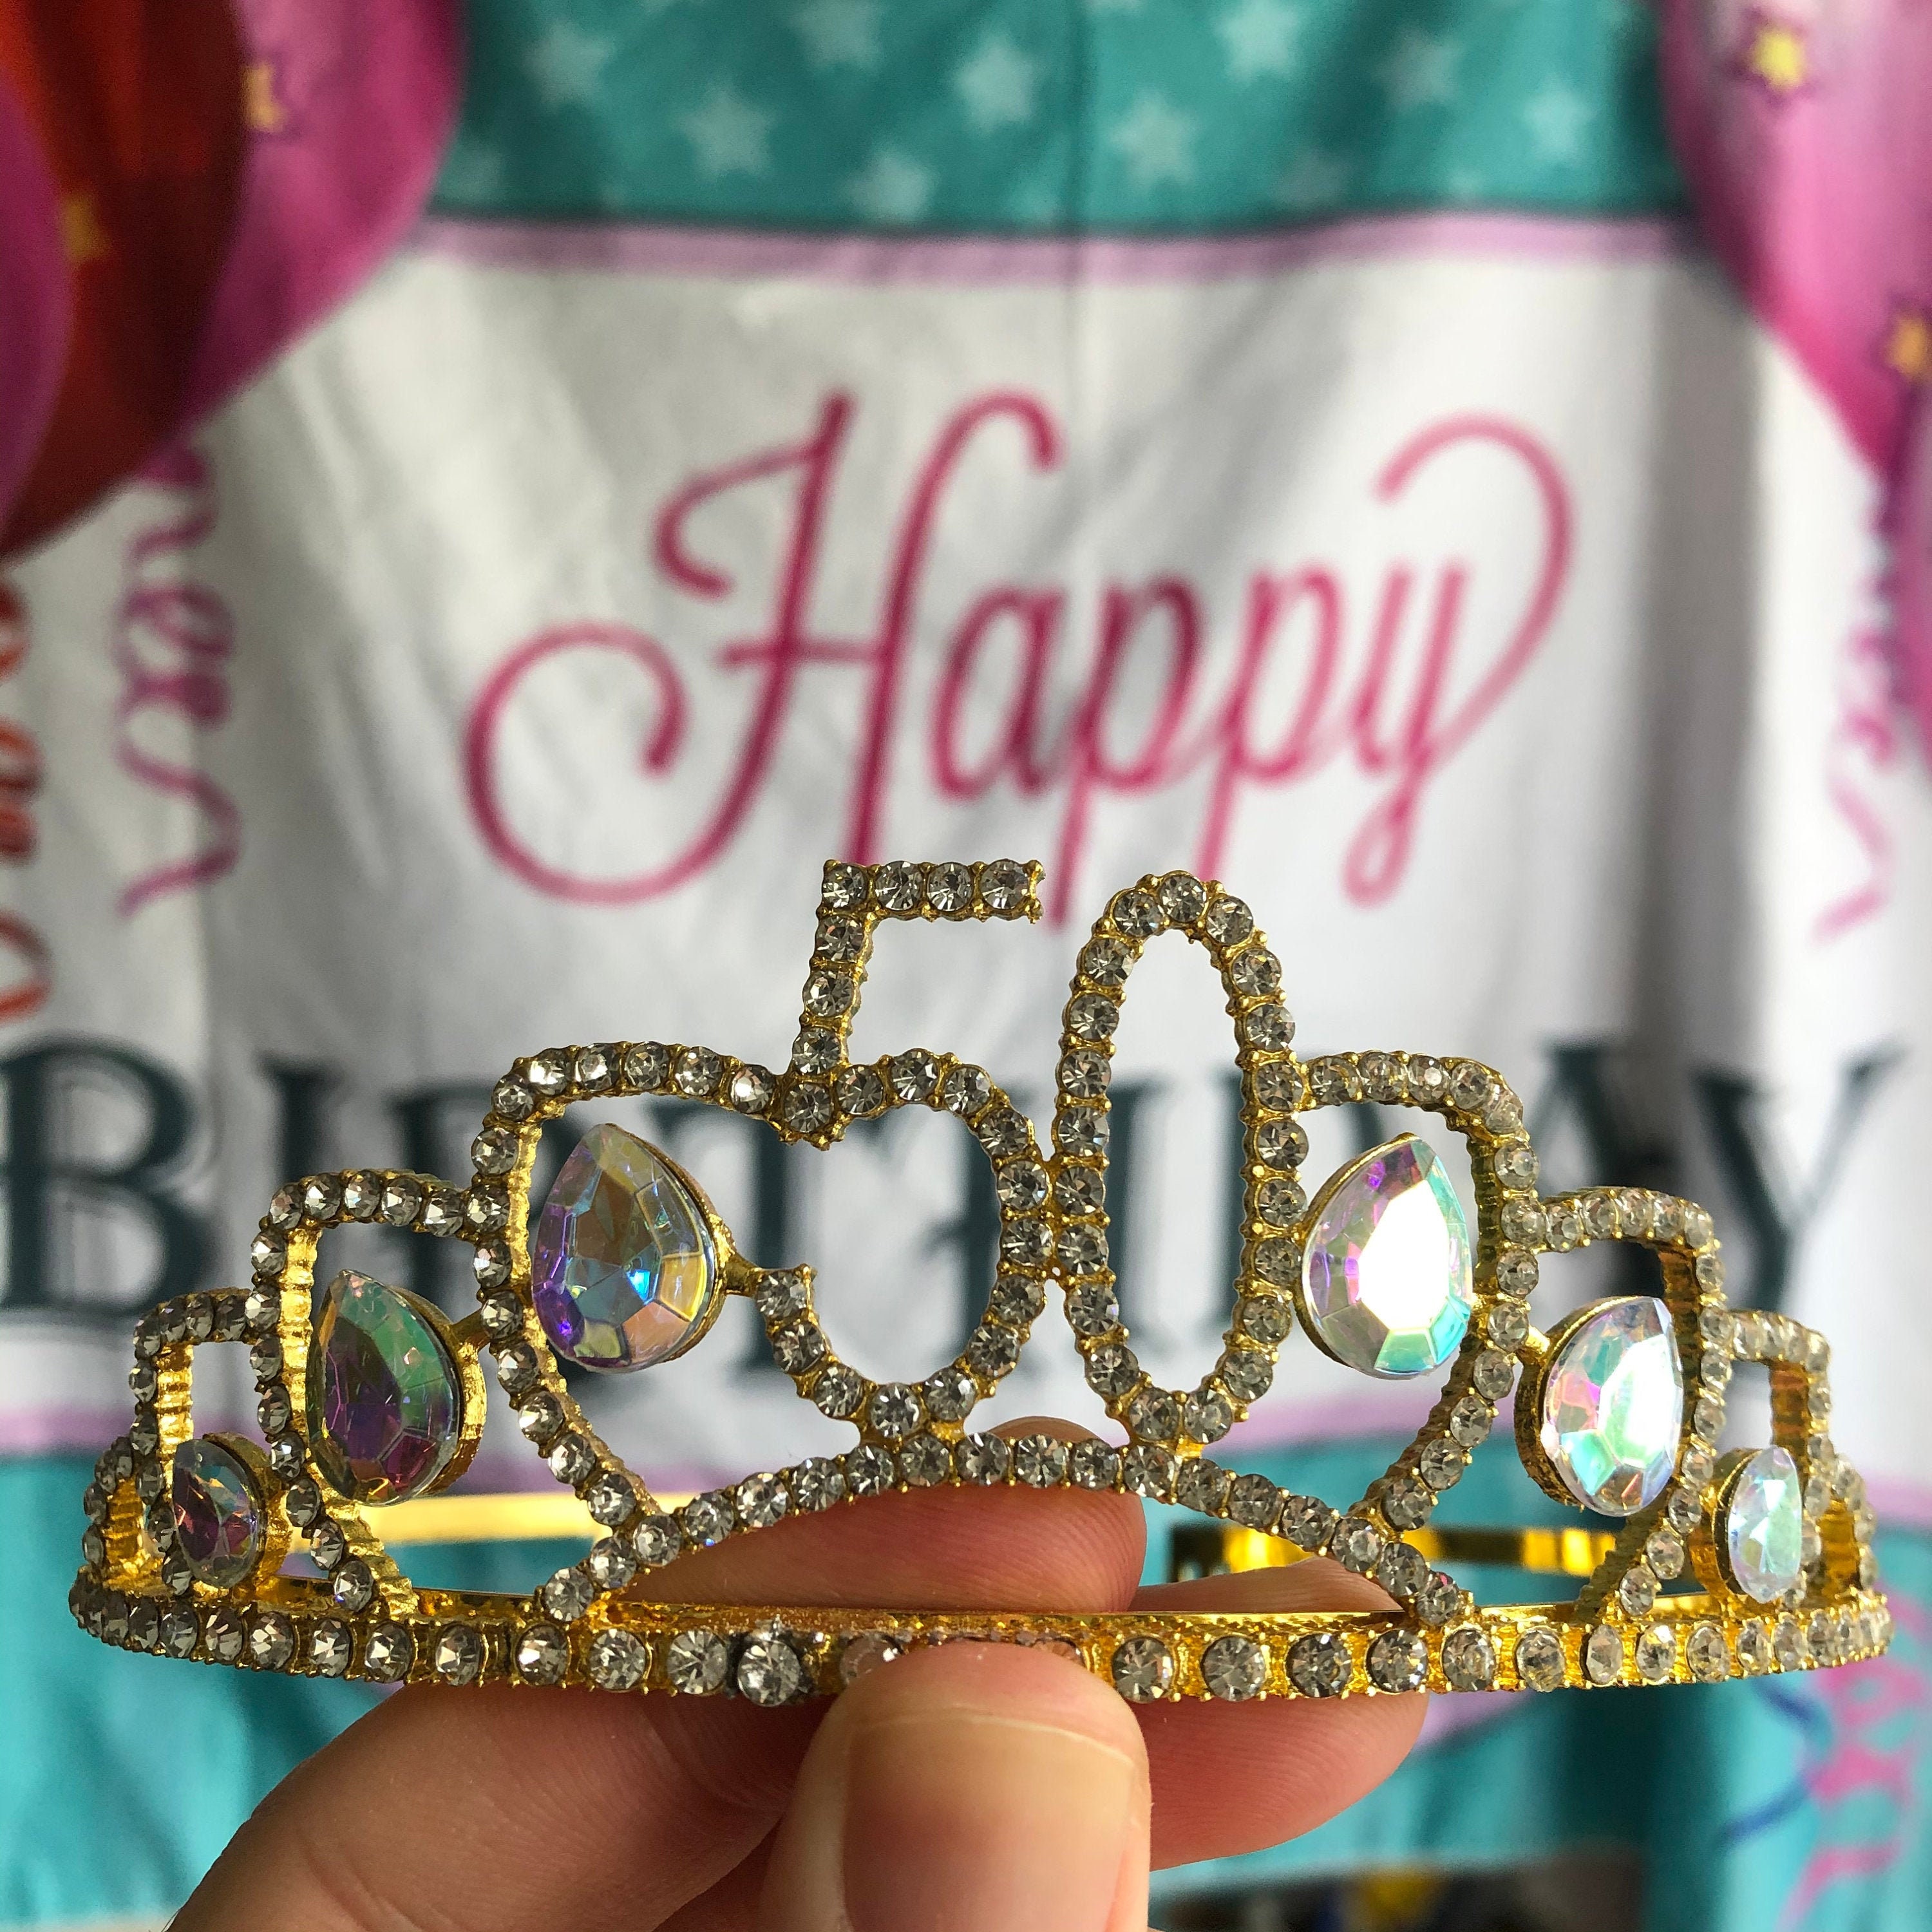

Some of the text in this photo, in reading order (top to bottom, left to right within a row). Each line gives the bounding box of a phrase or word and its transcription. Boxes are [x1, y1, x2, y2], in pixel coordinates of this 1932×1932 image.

[462, 388, 1577, 931] Happy
[0, 1032, 1909, 1383] BITHAY
[757, 858, 1298, 1441] 50
